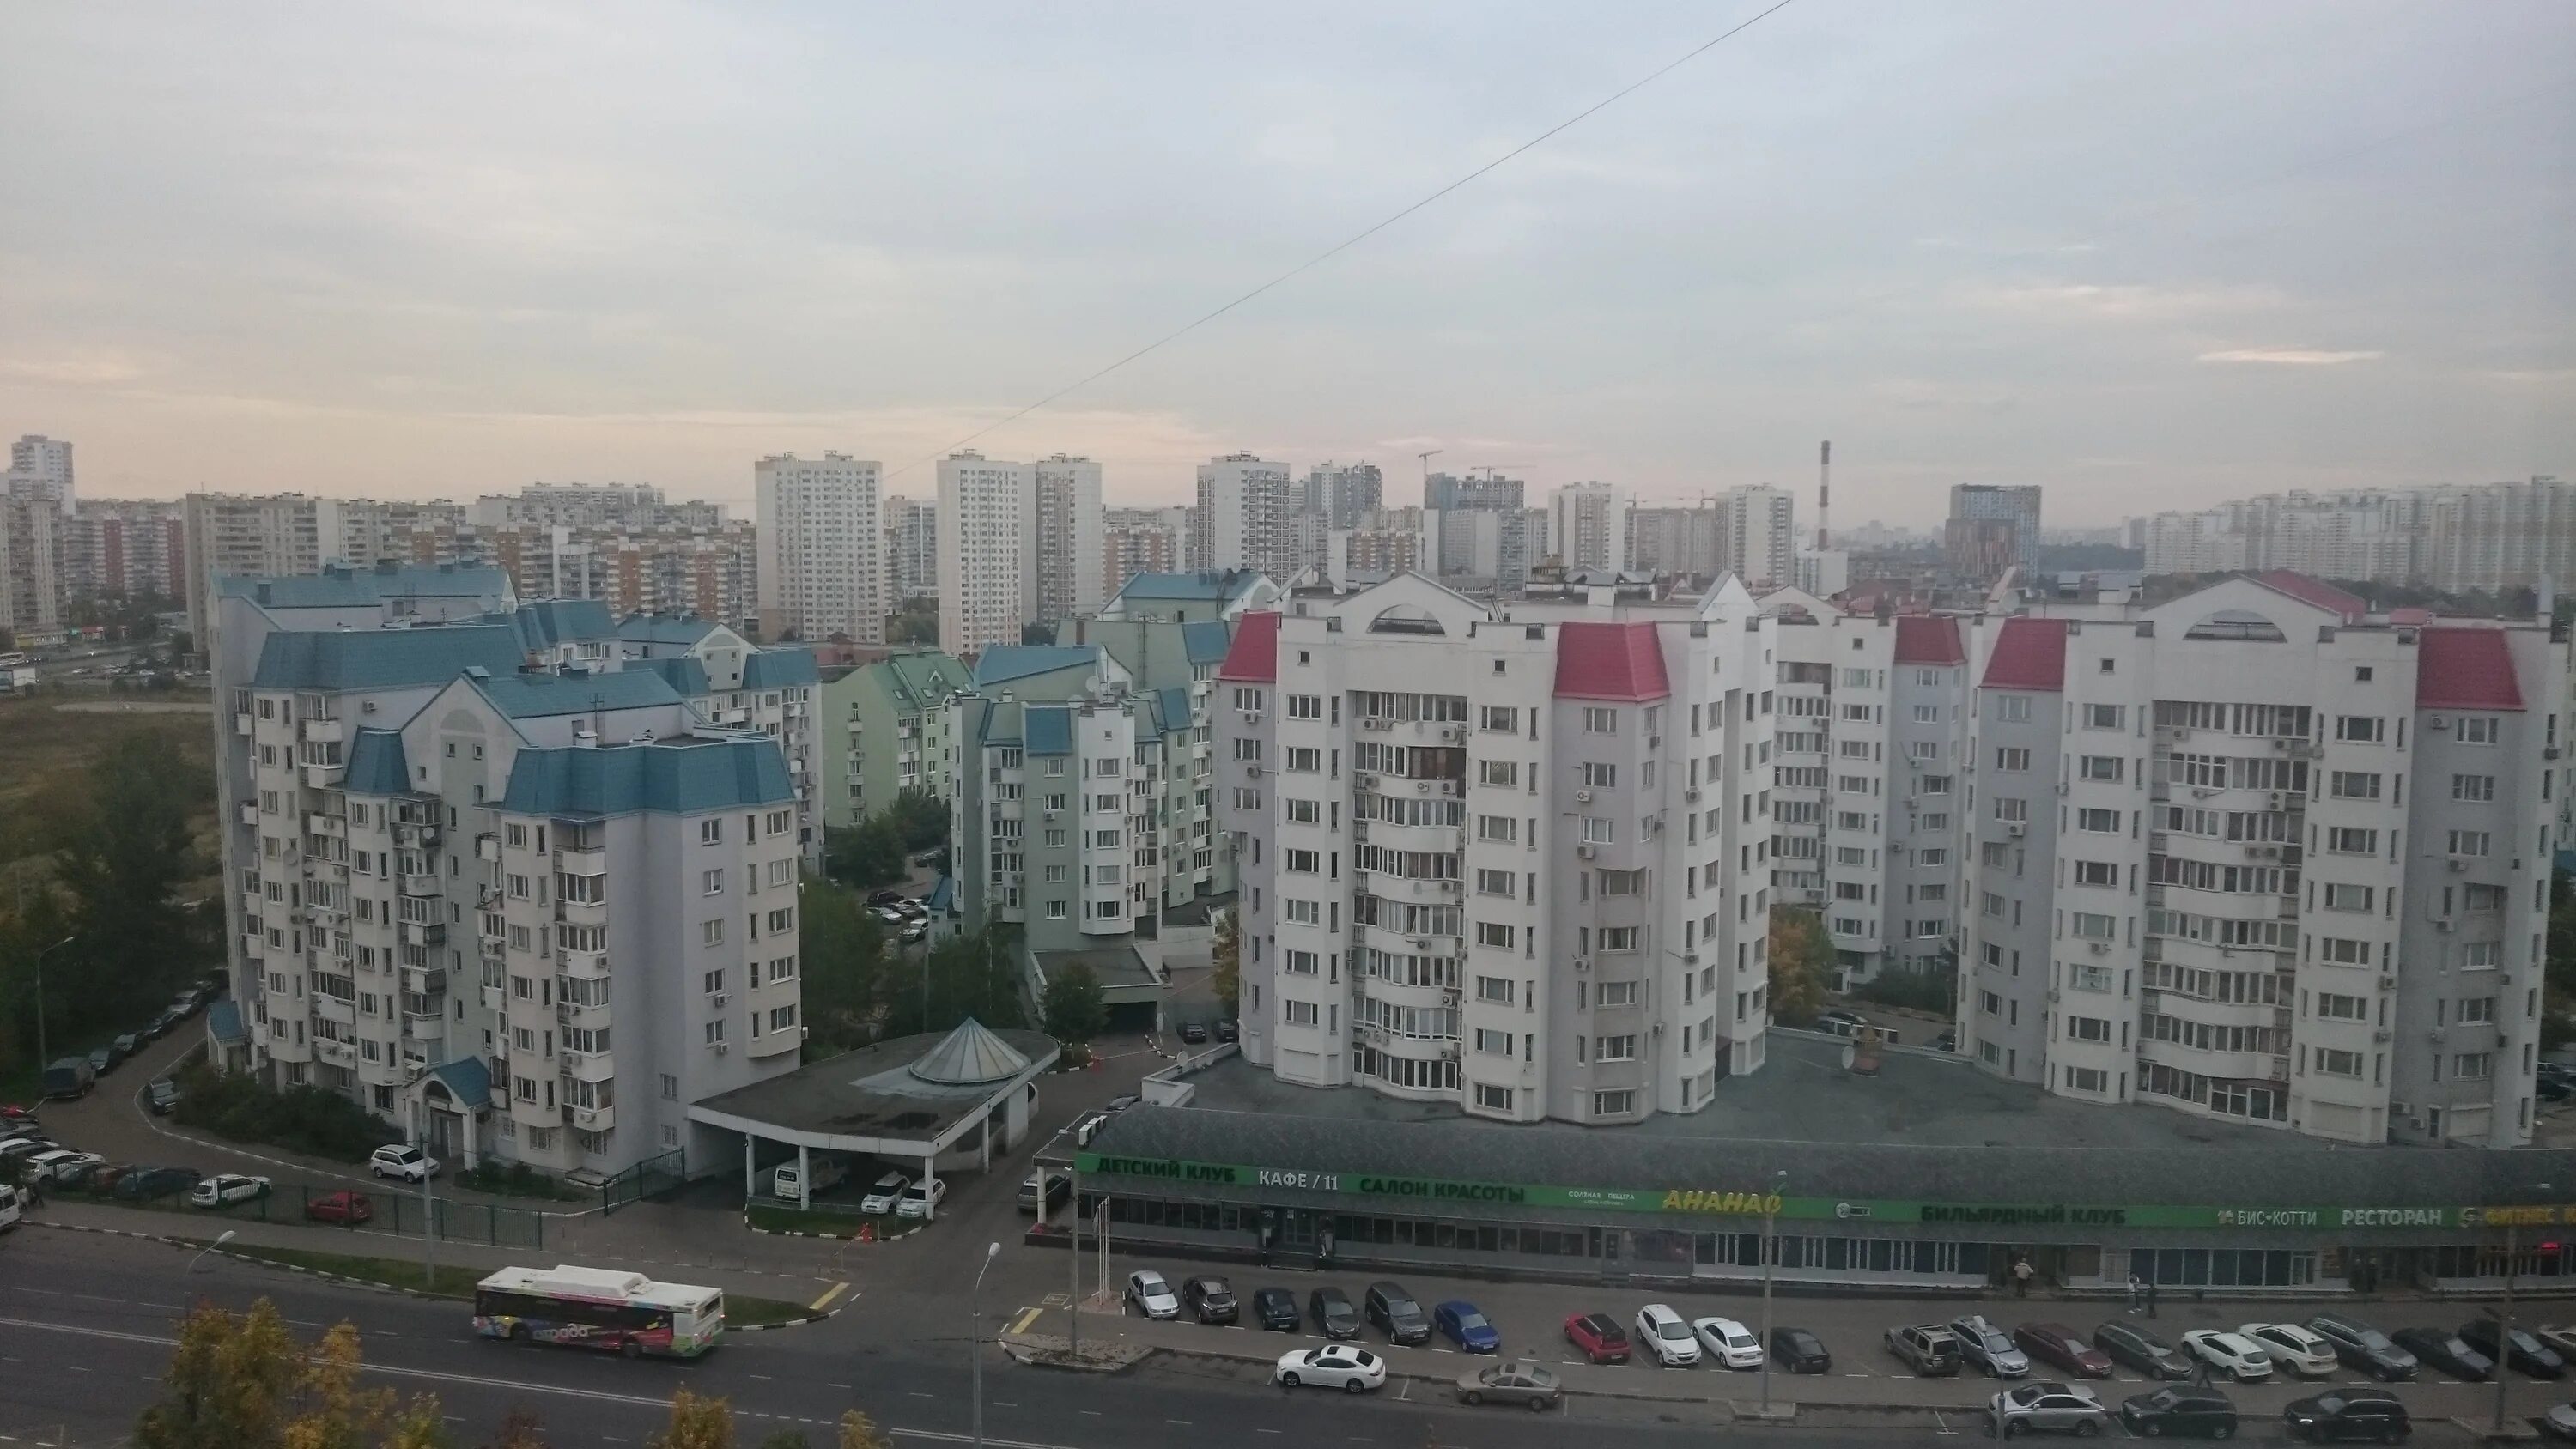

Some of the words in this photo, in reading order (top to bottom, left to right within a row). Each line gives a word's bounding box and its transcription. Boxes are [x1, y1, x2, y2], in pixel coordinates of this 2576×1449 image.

[1097, 1158, 1180, 1179] ДЕТСКИЙ
[1186, 1165, 1236, 1182] КЛУБ
[1259, 1170, 1307, 1188] КАФЕ
[1323, 1175, 1339, 1191] 11
[1360, 1178, 1427, 1197] САЛОН
[1434, 1183, 1524, 1202] КРАСОТЫ
[1568, 1191, 1601, 1199] СОЛЯНАЯ
[1607, 1192, 1635, 1201] ПЕЩЕРА
[1662, 1190, 1781, 1214] АНАНАС
[1921, 1204, 2064, 1224] БИЛЬЯРДНЫЙ
[2071, 1209, 2126, 1224] КЛУБ
[2342, 1210, 2442, 1226] РЕСТОРАН
